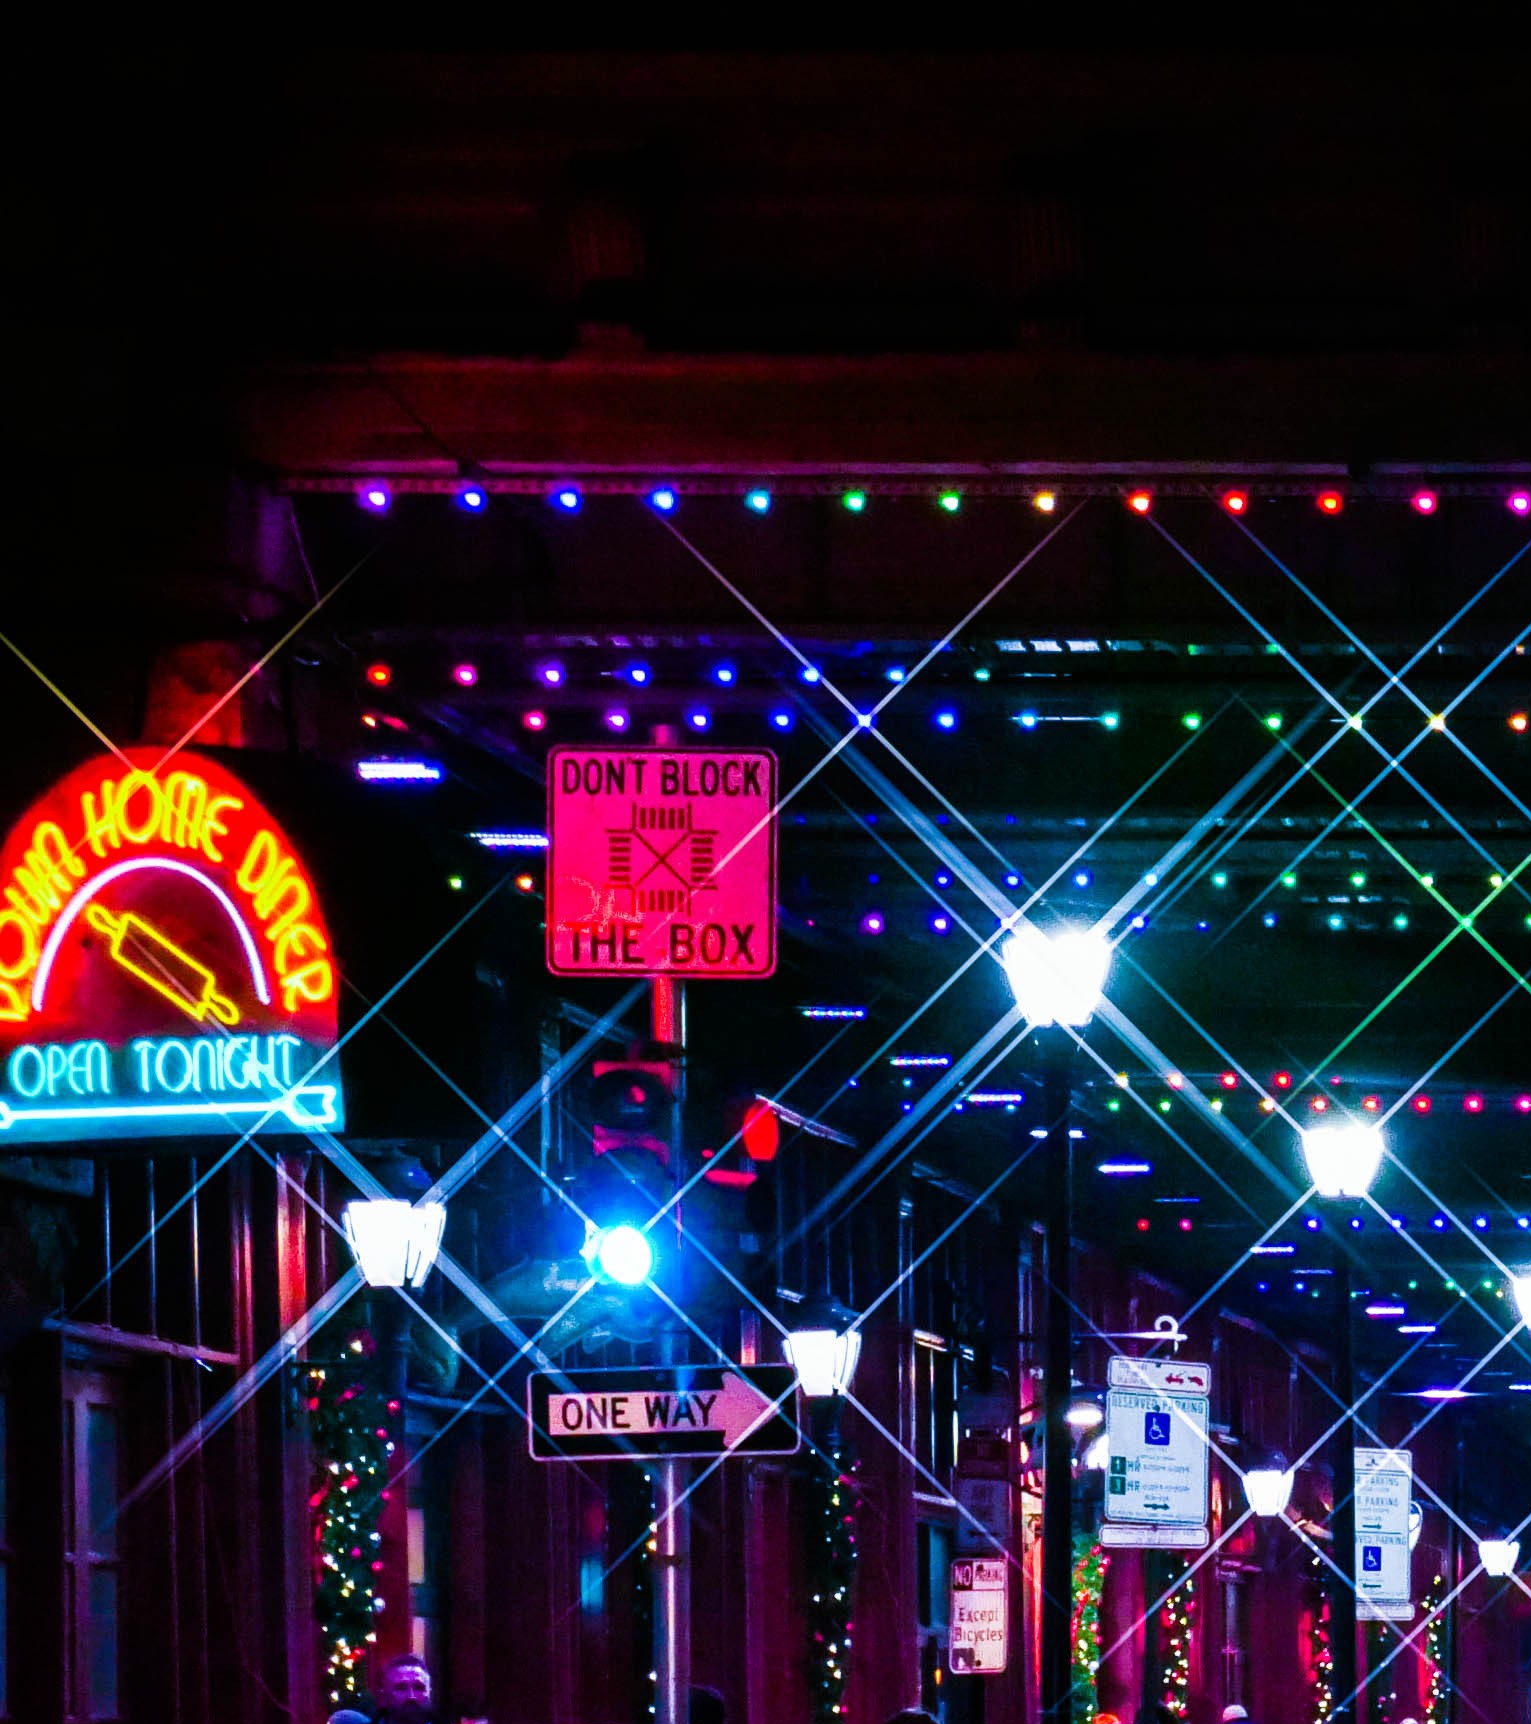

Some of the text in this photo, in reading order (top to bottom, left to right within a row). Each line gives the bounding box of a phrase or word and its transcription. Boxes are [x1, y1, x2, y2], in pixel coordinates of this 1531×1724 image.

[562, 759, 761, 797] DON'T BLOCK
[81, 770, 243, 862] HOME
[237, 830, 332, 1012] DINER
[565, 921, 754, 965] THE BOX
[9, 1034, 301, 1097] OPEN TONIGHT
[561, 1394, 717, 1431] ONE WAY
[954, 1564, 972, 1586] NO
[958, 1607, 998, 1622] Except
[954, 1626, 1003, 1645] Bicycles
